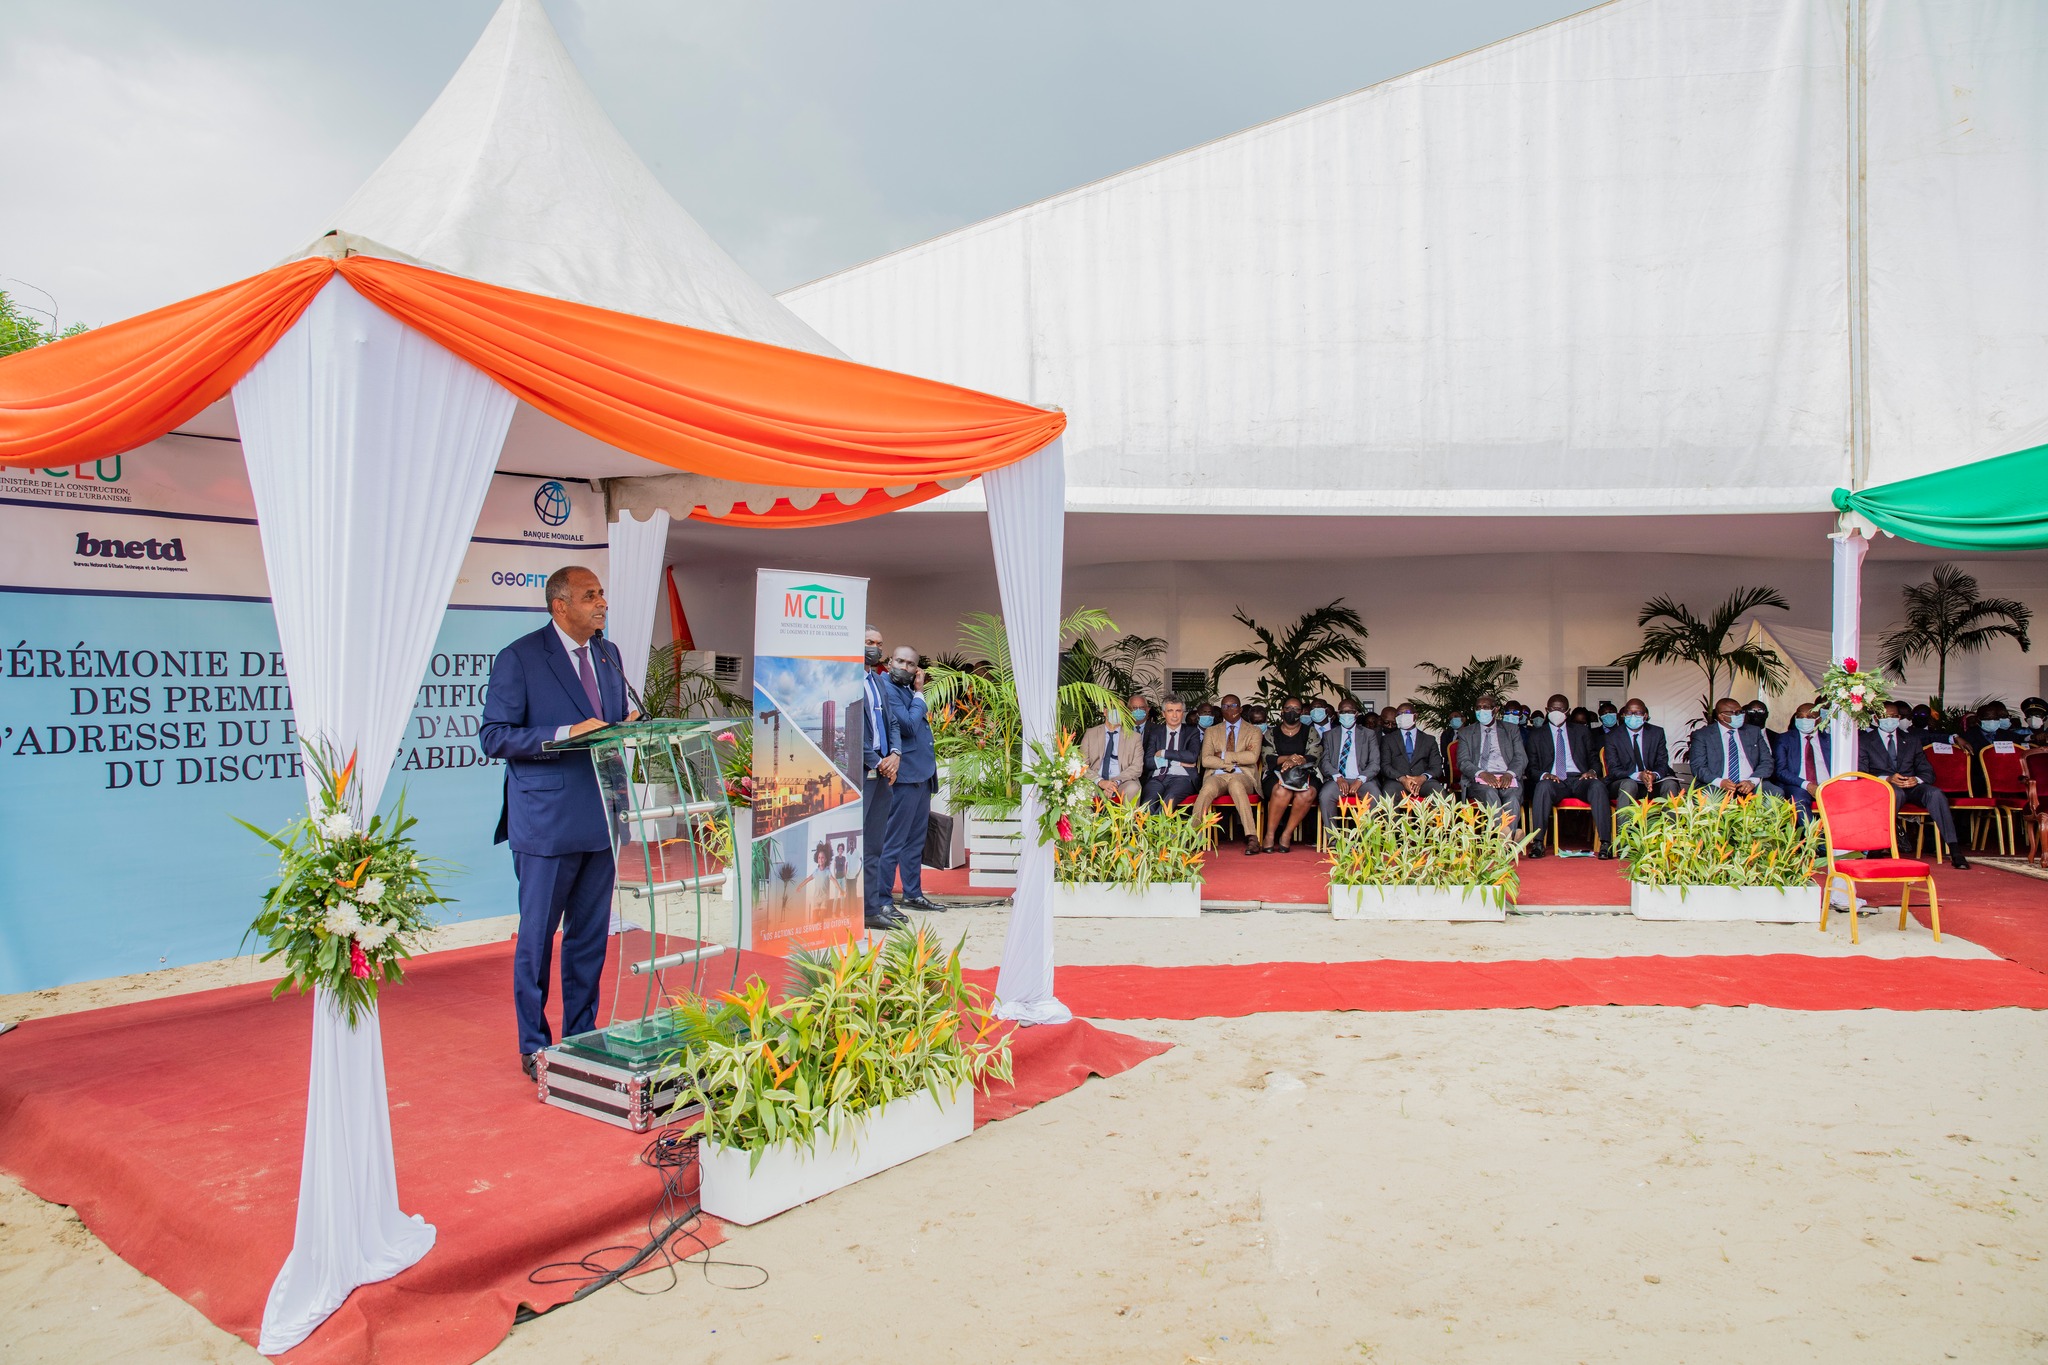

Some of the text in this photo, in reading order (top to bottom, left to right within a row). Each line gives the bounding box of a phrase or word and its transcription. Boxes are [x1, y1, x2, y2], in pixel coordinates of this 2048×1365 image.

[0, 454, 121, 482] LU
[0, 477, 131, 496] INISTÈRE DE LA CONSTRUCTION,
[5, 485, 52, 496] LOGEMENT
[54, 489, 64, 497] ET
[66, 490, 78, 499] DE
[79, 492, 132, 502] L'URBANISME
[76, 532, 187, 561] bnetd
[523, 530, 584, 541] BANQUE MONDIALE
[784, 593, 844, 620] MCLU
[0, 640, 228, 678] ÉRÉMONIE
[70, 687, 151, 715] DES
[0, 722, 206, 755] 'ADRESSE
[218, 719, 271, 747] DU
[416, 715, 483, 739] D'AD
[105, 759, 164, 789] DU
[763, 932, 773, 940] NOS
[774, 928, 795, 939] ACTIONS
[803, 922, 822, 933] SERVICE
[831, 918, 850, 928] CITOYEN
